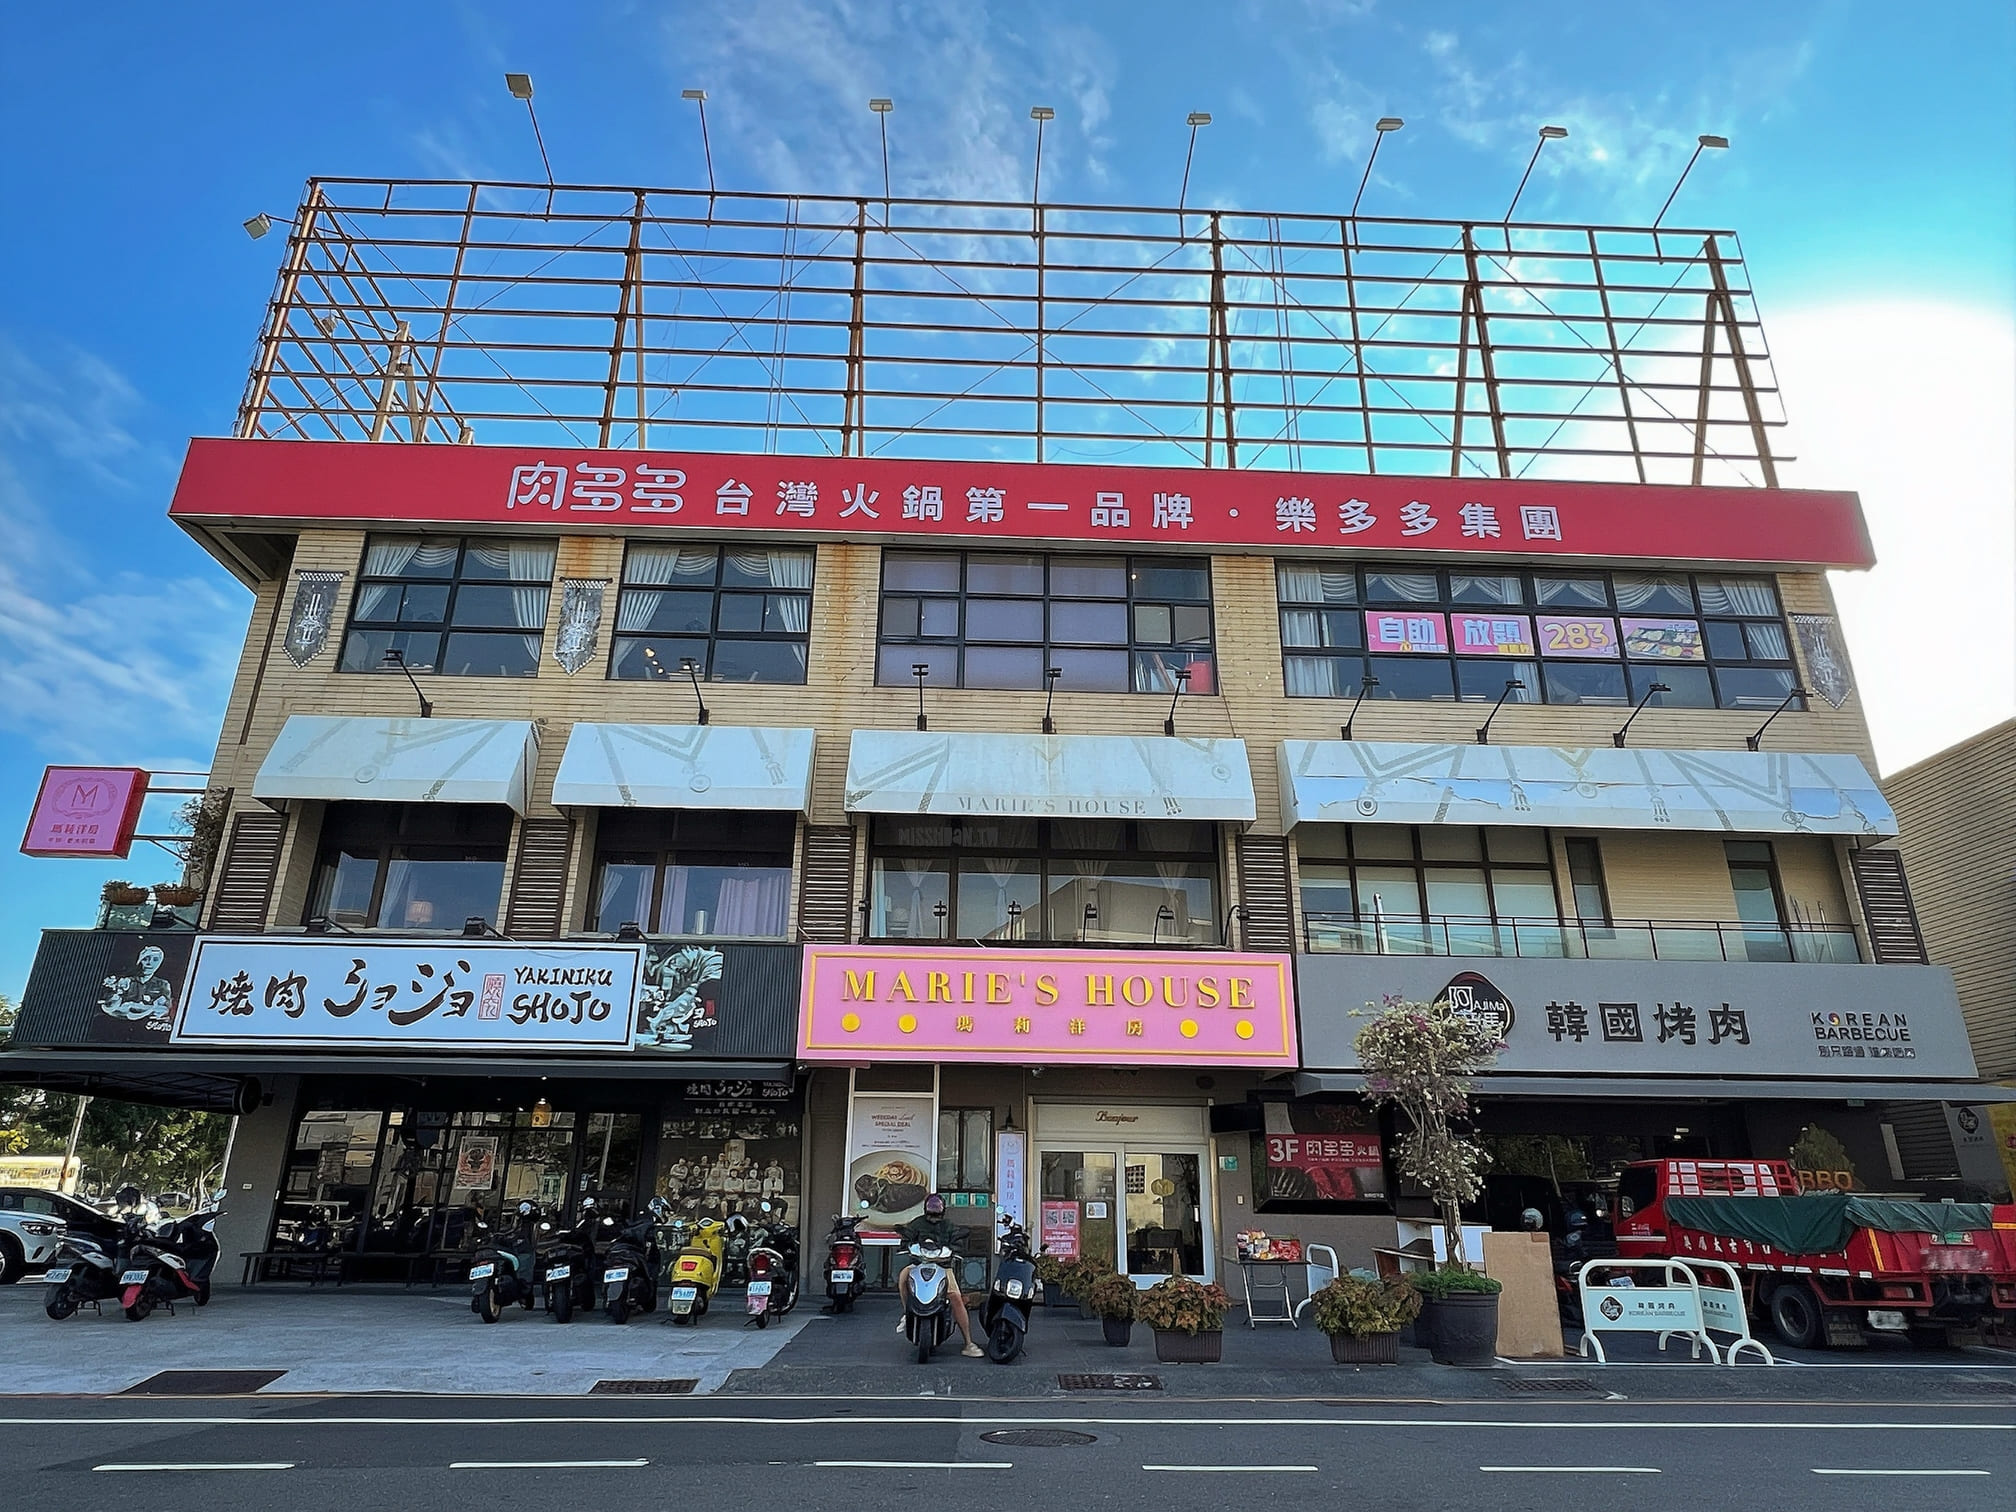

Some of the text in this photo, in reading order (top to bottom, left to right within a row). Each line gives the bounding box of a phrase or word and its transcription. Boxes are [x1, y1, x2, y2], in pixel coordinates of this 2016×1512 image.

[506, 459, 689, 514] 肉多多
[1378, 616, 1610, 650] 自助 放題 283
[1069, 799, 1147, 816] HOUSE
[514, 965, 613, 986] YAKINIKU
[841, 968, 1256, 1009] MARIE'S HOUSE
[505, 991, 612, 1024] SHOJO
[1810, 1012, 1908, 1026] KOREAN
[955, 1015, 1144, 1037] 瑪莉洋房
[1544, 1000, 1752, 1046] 韓國烤肉
[1815, 1027, 1911, 1042] BARBECUE
[1095, 1110, 1139, 1125] Bonjour
[1269, 1138, 1299, 1163] 3F
